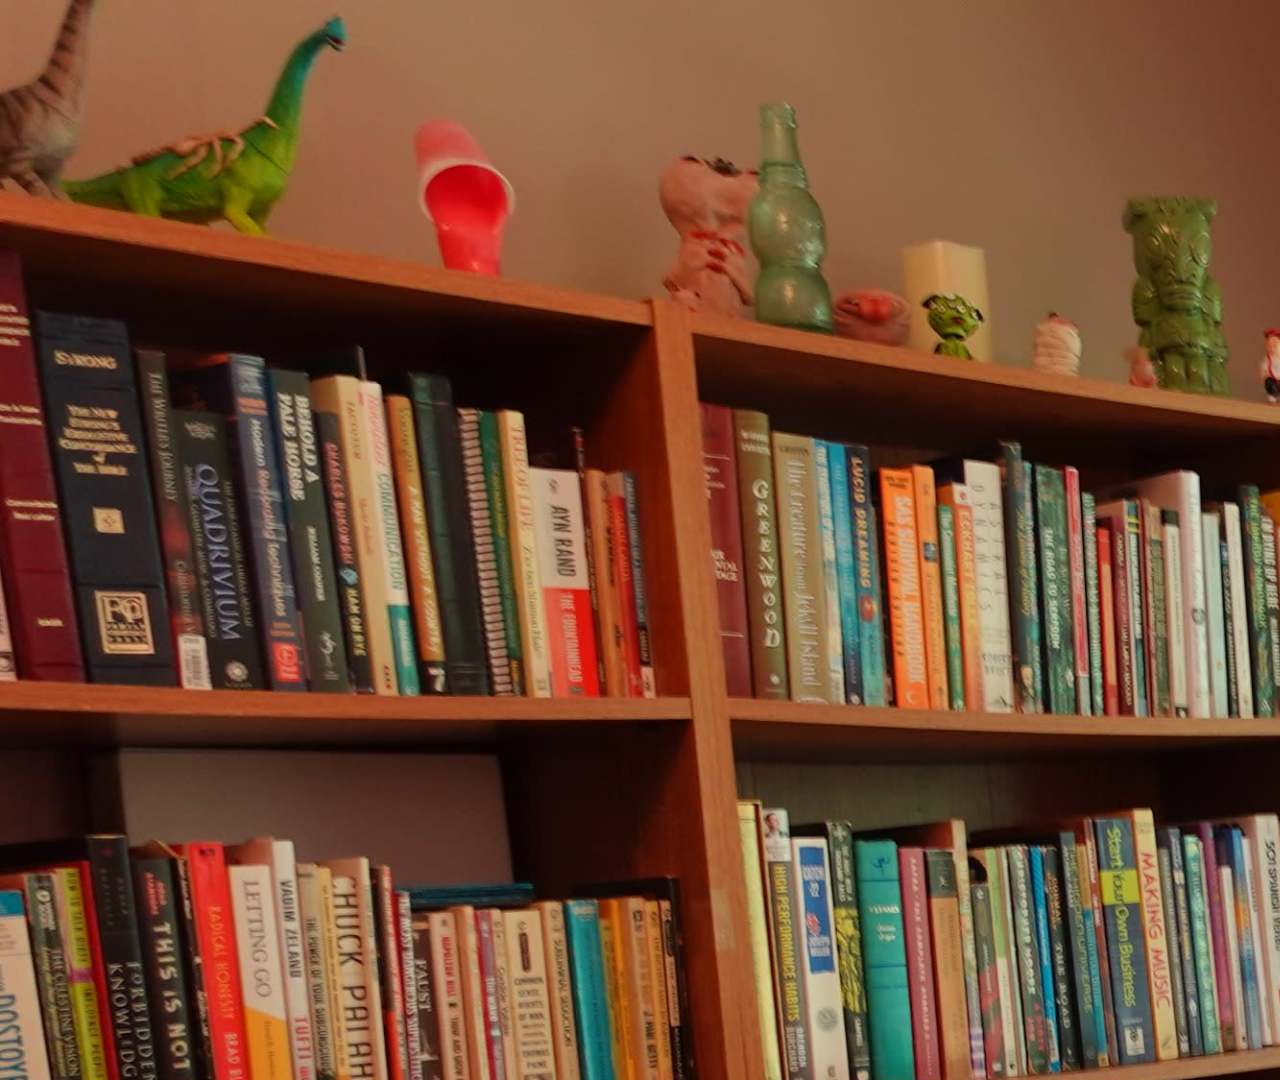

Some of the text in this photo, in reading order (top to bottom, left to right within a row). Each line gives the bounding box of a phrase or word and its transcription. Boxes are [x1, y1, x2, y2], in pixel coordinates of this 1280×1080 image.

[276, 391, 305, 502] PALE HORSE
[293, 392, 319, 483] BEHOLD A
[323, 441, 344, 497] CHARLES
[194, 462, 243, 641] QUADRIVIUM
[249, 417, 267, 466] Modern
[265, 541, 287, 616] Techniques
[551, 502, 576, 578] AYN RAND
[850, 456, 875, 588] LUCID DREAMING
[1106, 826, 1124, 868] Start
[152, 921, 178, 981] THIS
[242, 879, 271, 999] LETTING GO
[277, 879, 303, 978] VADIM ZELAND
[328, 875, 366, 969] CHUCK
[772, 863, 800, 1021] HIGH PERFORMANCE HABITS
[1115, 905, 1131, 942] Own
[1139, 850, 1170, 1009] MAKING MUSIC
[162, 987, 181, 1014] IS
[414, 958, 430, 1012] FAUST
[1117, 943, 1138, 1007] Business
[168, 1022, 191, 1070] NOT
